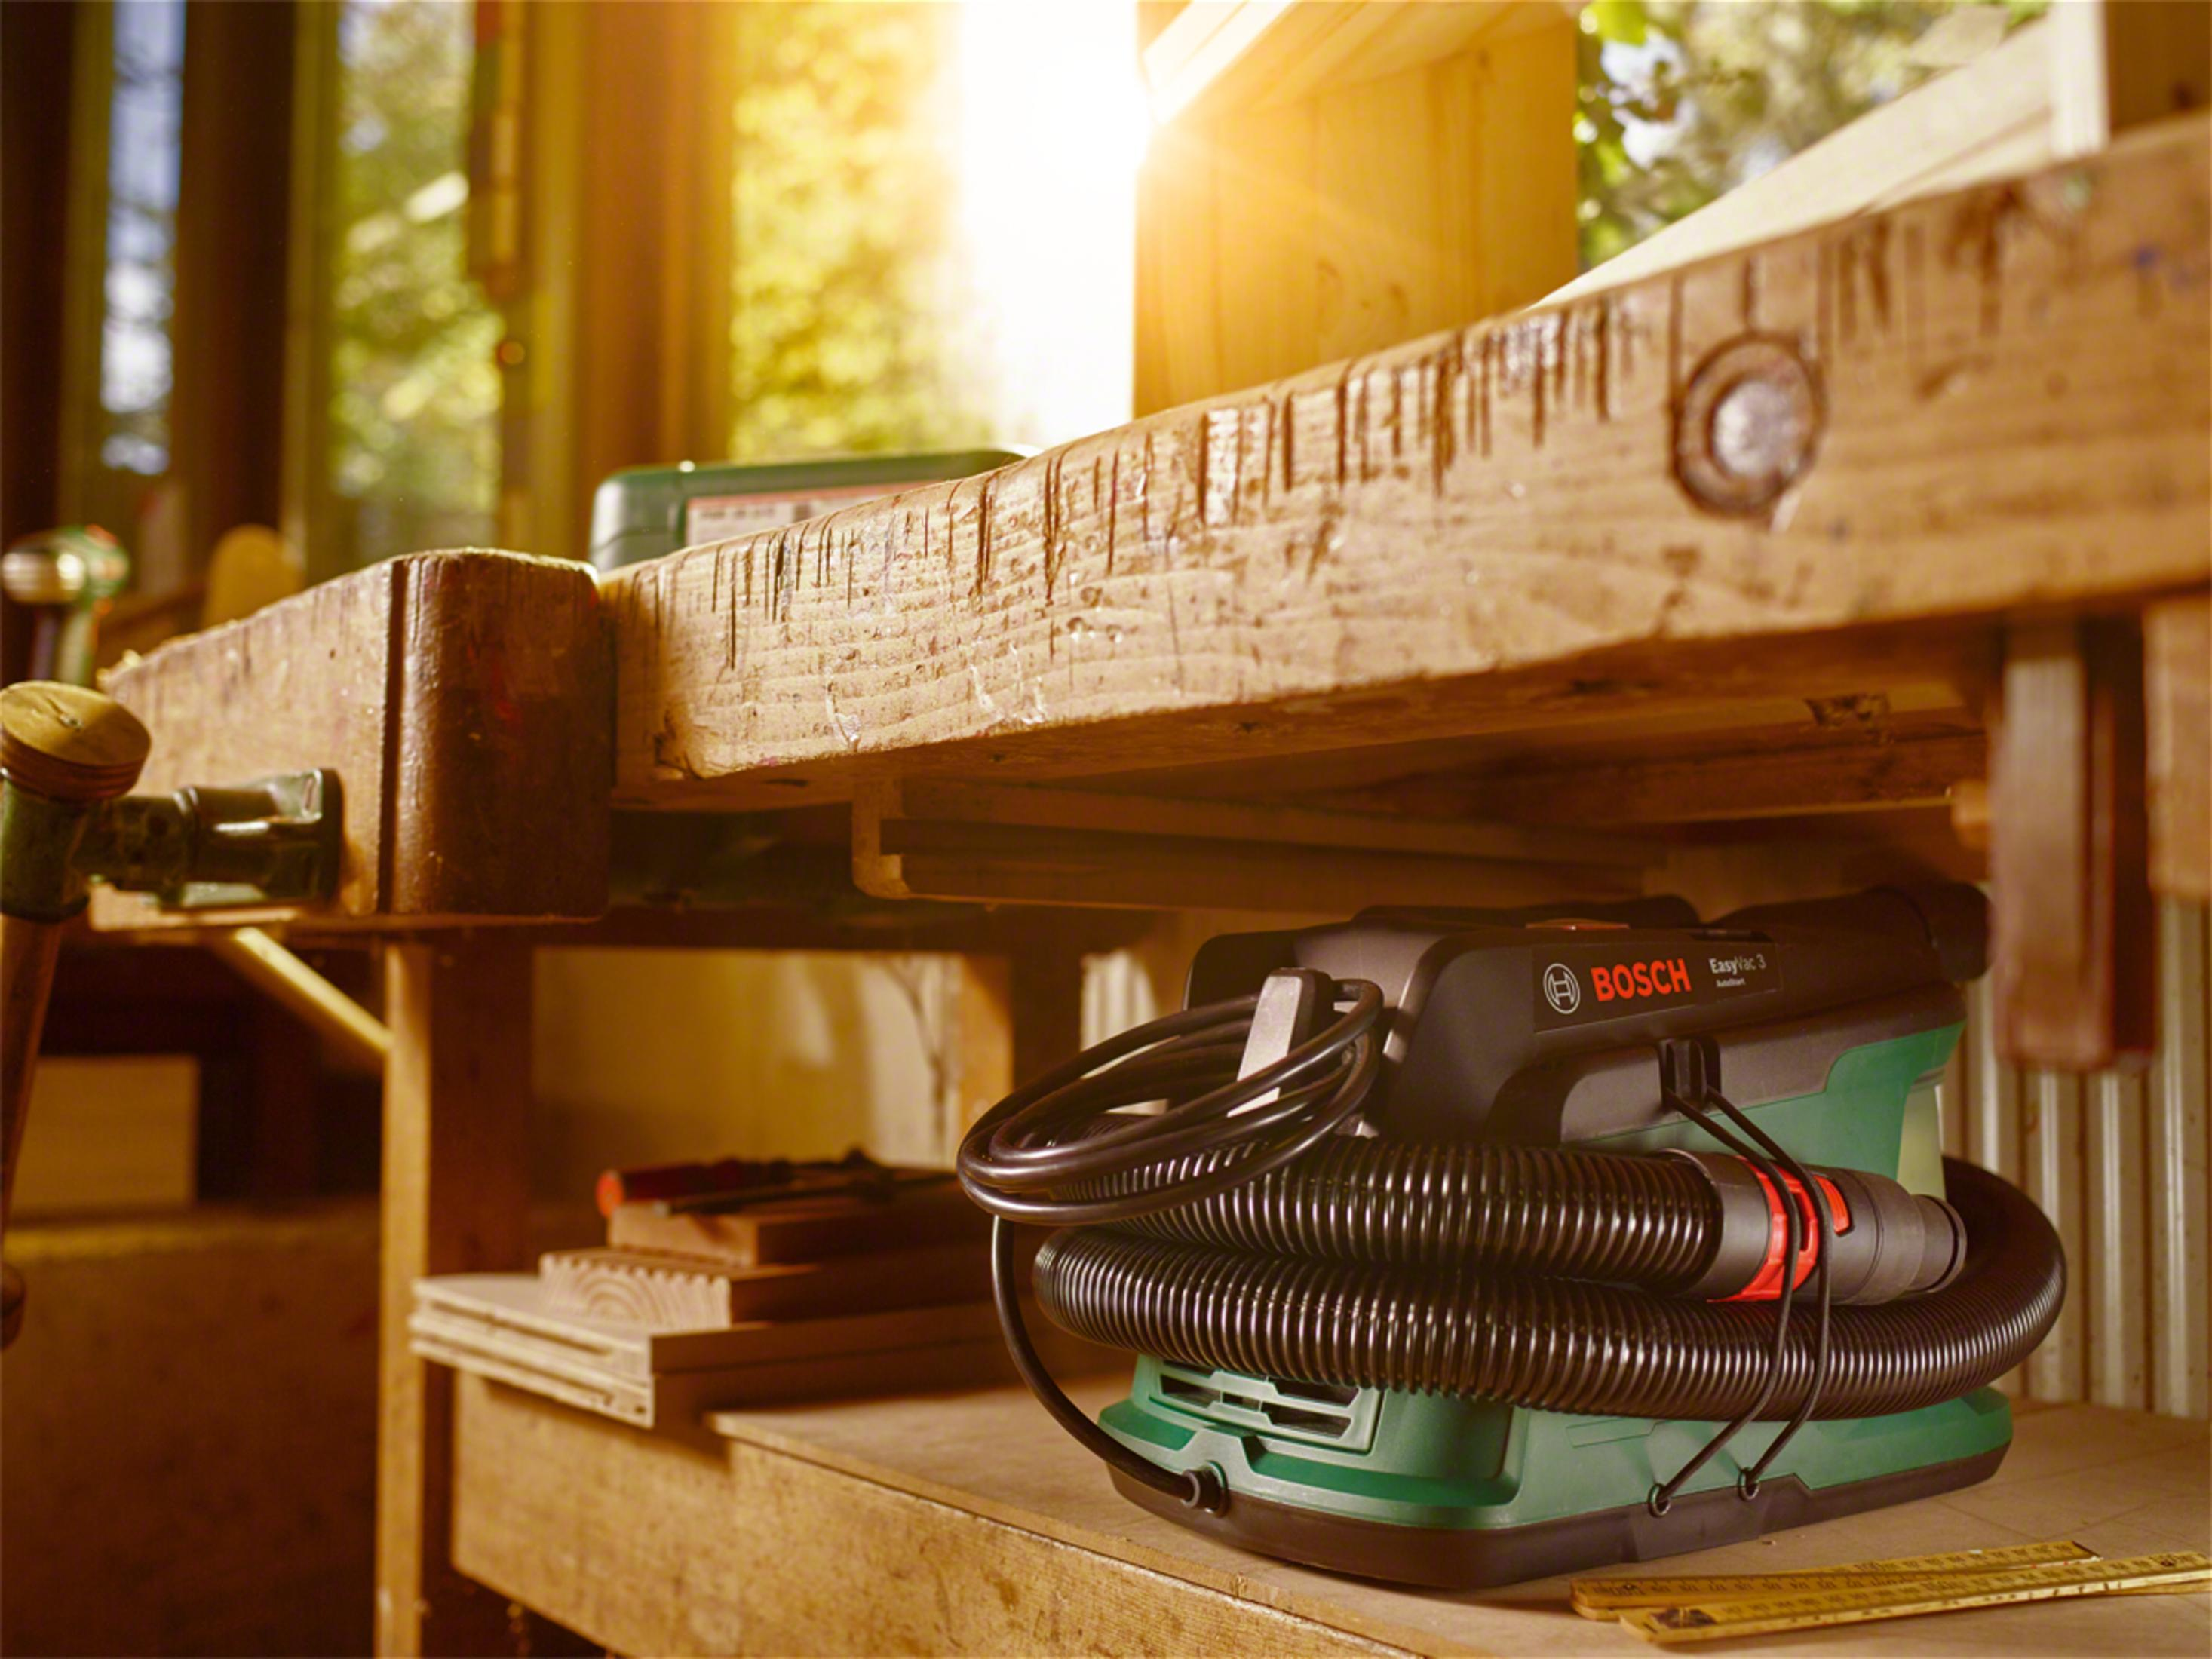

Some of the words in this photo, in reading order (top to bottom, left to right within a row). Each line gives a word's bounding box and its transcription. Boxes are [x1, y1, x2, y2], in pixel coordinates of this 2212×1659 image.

[1591, 958, 1692, 1001] BOSCH
[1708, 955, 1756, 975] EasyVac
[1756, 953, 1766, 969] 3
